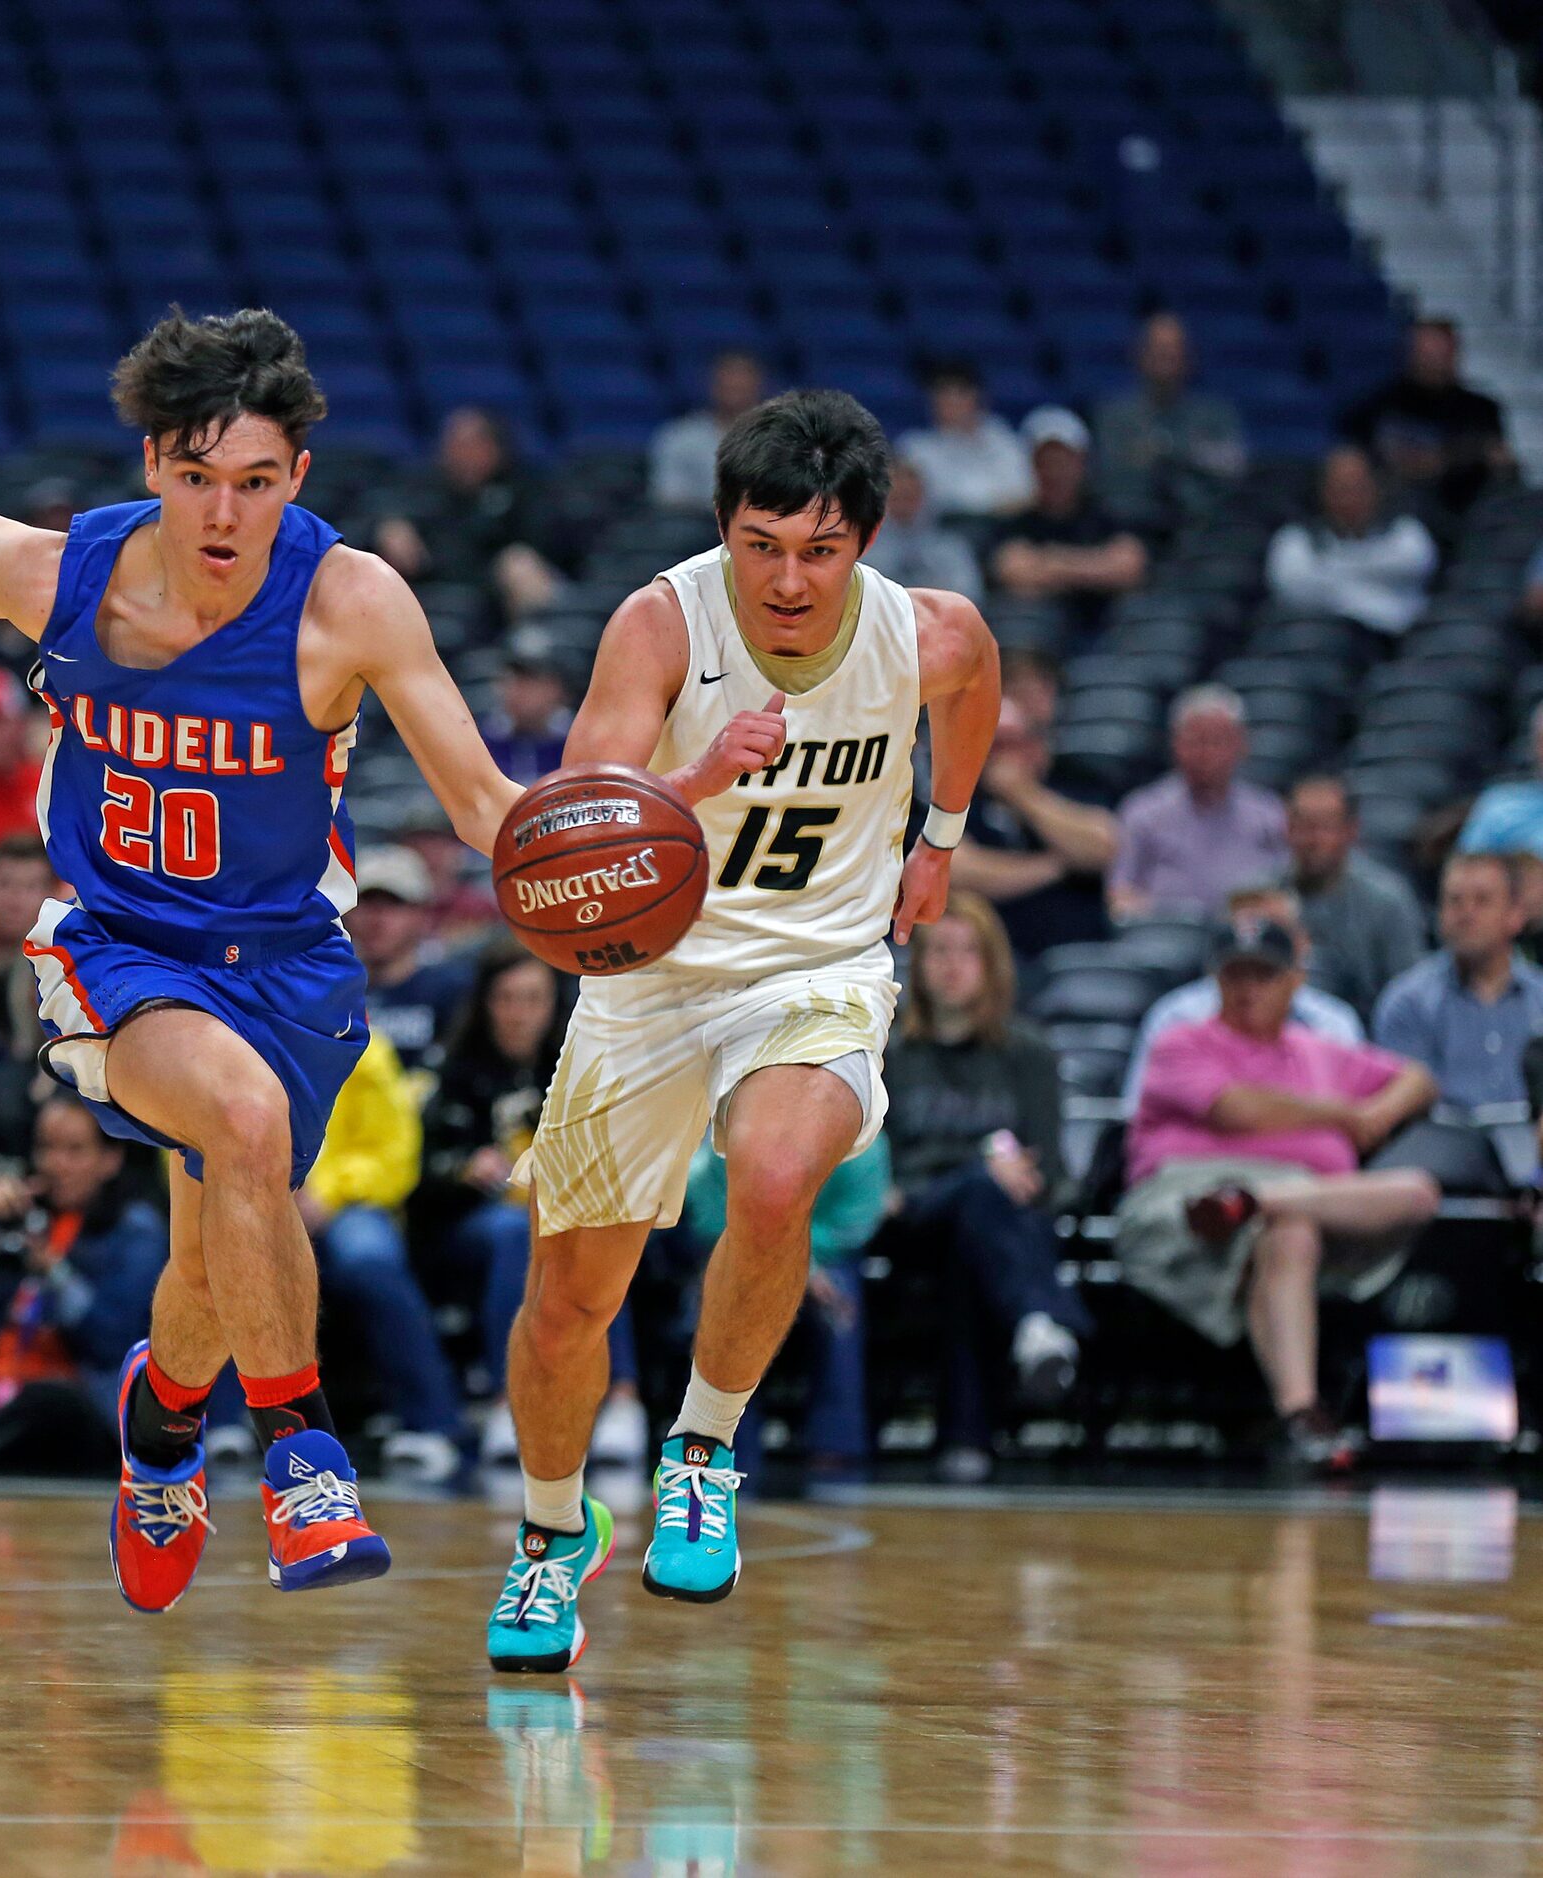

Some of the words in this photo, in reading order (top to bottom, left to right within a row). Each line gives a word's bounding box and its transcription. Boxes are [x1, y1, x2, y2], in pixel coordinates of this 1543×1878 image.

[61, 693, 285, 776] LIDELL
[737, 734, 890, 788] YTON
[99, 763, 221, 881] 20
[538, 806, 641, 839] PLATINUM
[716, 804, 844, 892] 15
[516, 848, 660, 913] SPALDING
[225, 945, 239, 964] S
